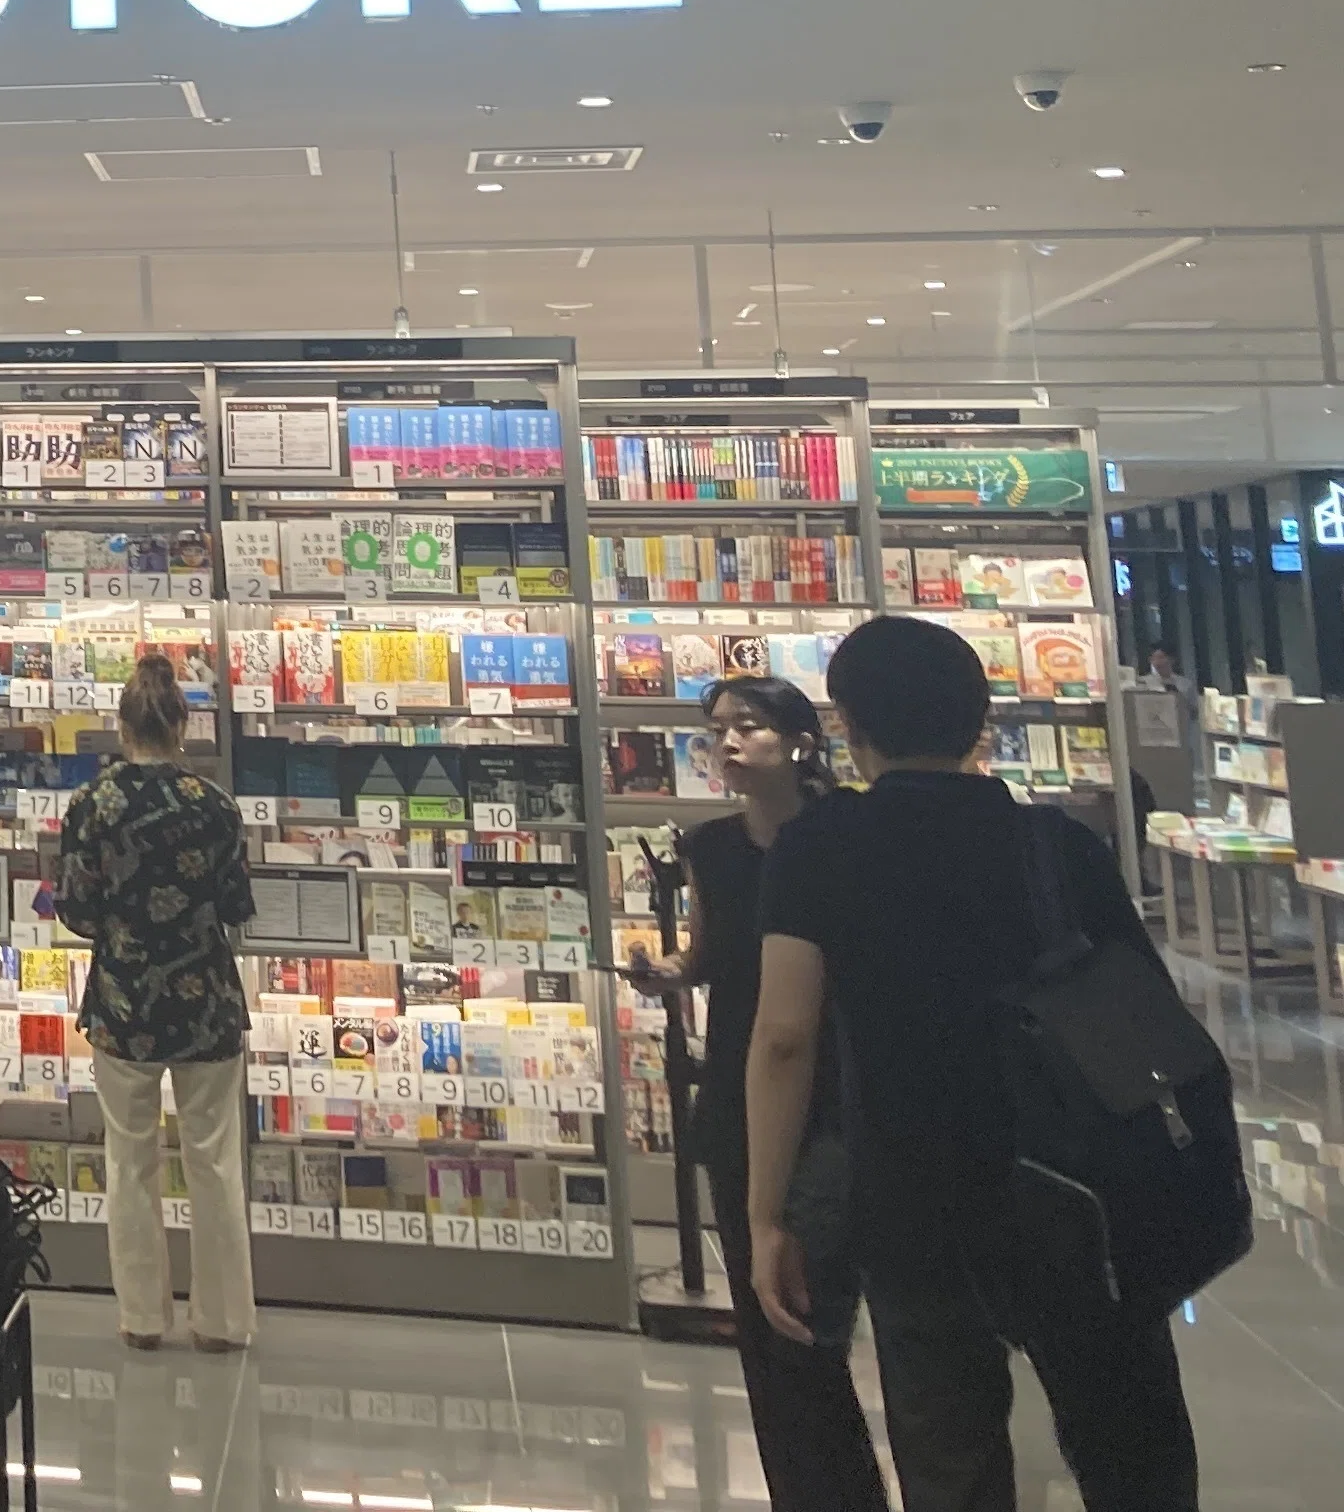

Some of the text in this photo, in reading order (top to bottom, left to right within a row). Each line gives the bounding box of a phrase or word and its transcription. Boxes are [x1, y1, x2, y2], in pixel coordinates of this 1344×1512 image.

[26, 347, 74, 359] ランキング
[134, 438, 153, 460] N
[178, 438, 198, 461] N
[22, 464, 29, 483] 1
[103, 464, 118, 483] 2
[143, 464, 156, 483] 3
[373, 465, 381, 483] 1
[395, 522, 454, 539] 論理的
[64, 577, 76, 594] 5
[108, 577, 121, 595] 6
[147, 578, 159, 596] 7
[189, 579, 202, 597] 8
[248, 579, 260, 597] 2
[364, 580, 377, 598] 3
[497, 581, 512, 598] 4
[470, 654, 509, 668] われる
[521, 655, 561, 670] われる
[25, 686, 41, 704] 11
[68, 686, 88, 705] 12
[253, 689, 266, 709] 5
[374, 691, 388, 711] 6
[489, 692, 502, 710] 7
[30, 794, 49, 814] 17
[254, 801, 269, 821] 8
[379, 805, 393, 824] 9
[490, 807, 512, 827] 10
[31, 927, 39, 945] 1
[390, 940, 398, 959] 1
[472, 944, 485, 963] 2
[516, 944, 530, 963] 3
[564, 946, 578, 964] 4
[41, 1060, 55, 1080] 8
[267, 1071, 281, 1091] 5
[311, 1073, 325, 1092] 6
[353, 1075, 365, 1095] 7
[397, 1077, 411, 1097] 8
[442, 1080, 457, 1100] 9
[480, 1082, 505, 1103] 10
[530, 1085, 550, 1105] 11
[575, 1086, 598, 1108] 12
[82, 1197, 103, 1217] 17
[264, 1207, 288, 1229] 13
[307, 1211, 330, 1233] 14
[354, 1214, 379, 1237] 15
[398, 1215, 422, 1237] 16
[446, 1219, 469, 1242] 17
[492, 1223, 517, 1245] 18
[537, 1226, 561, 1249] 19
[583, 1229, 608, 1253] 20
